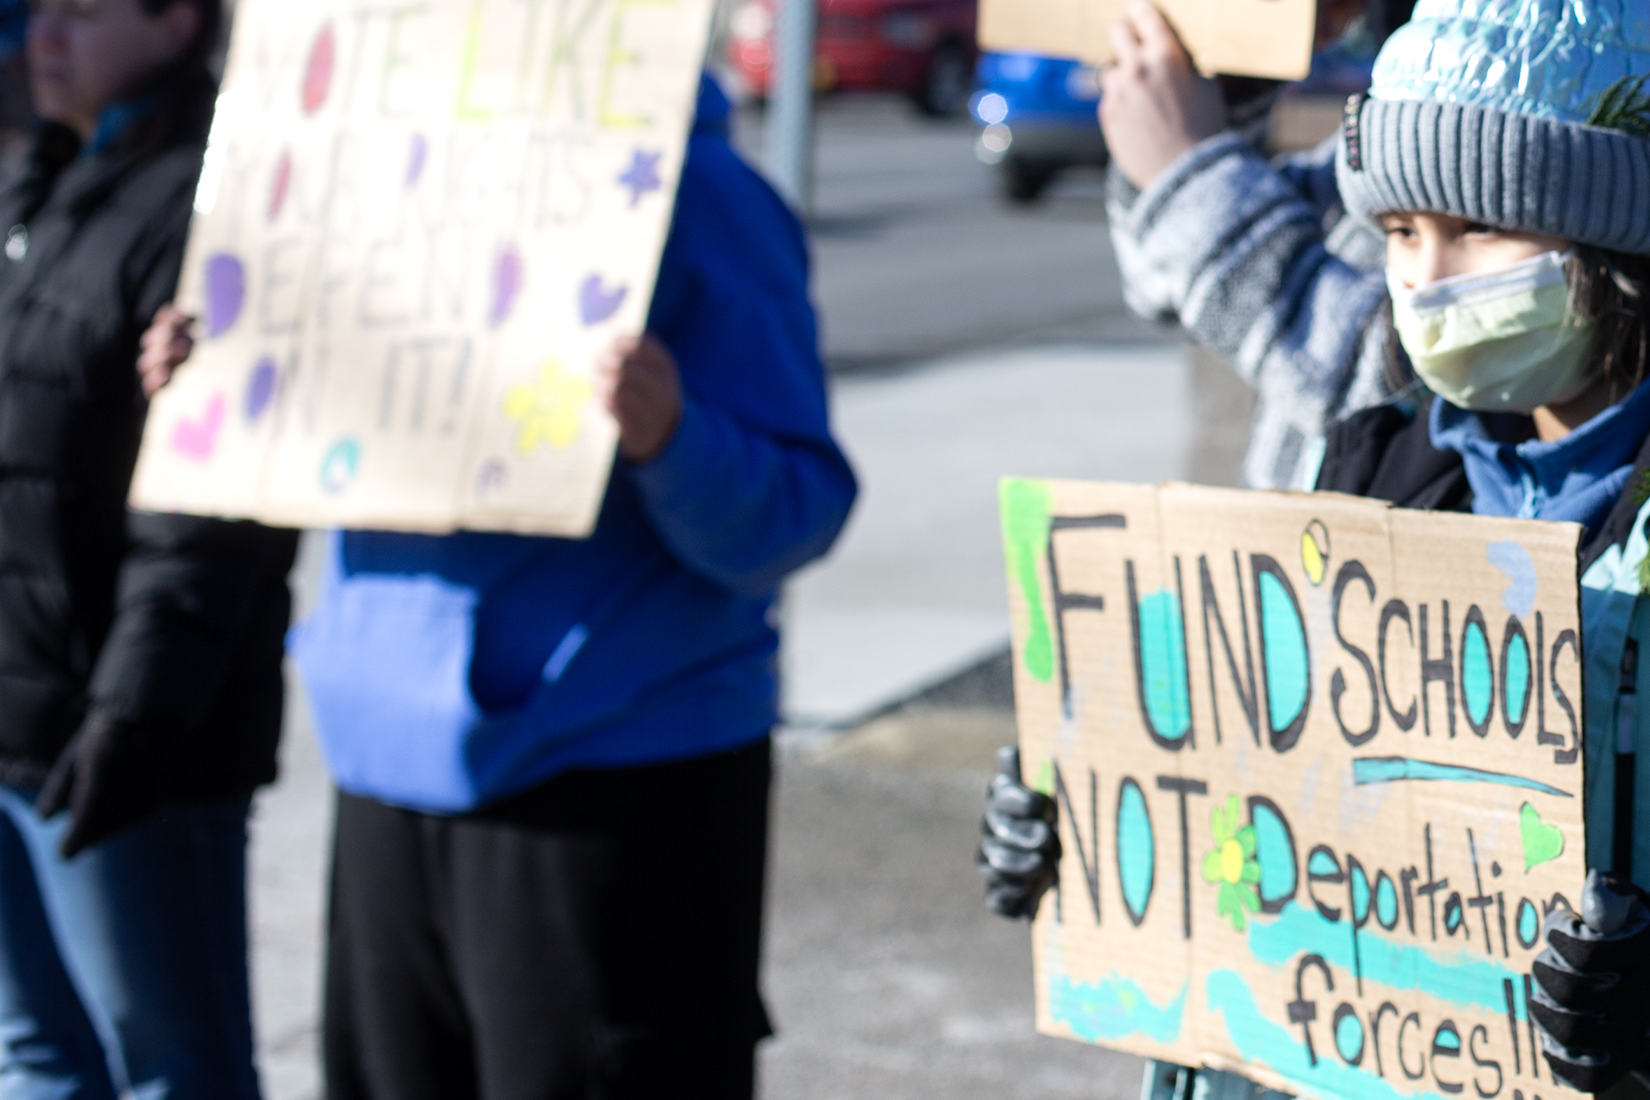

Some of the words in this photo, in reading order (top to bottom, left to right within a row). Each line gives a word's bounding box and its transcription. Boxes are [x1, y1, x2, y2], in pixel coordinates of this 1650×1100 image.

[377, 334, 475, 438] IT!
[1048, 513, 1313, 753] FUND
[1330, 560, 1581, 765] SCHOOLS
[1053, 757, 1208, 940] NOT
